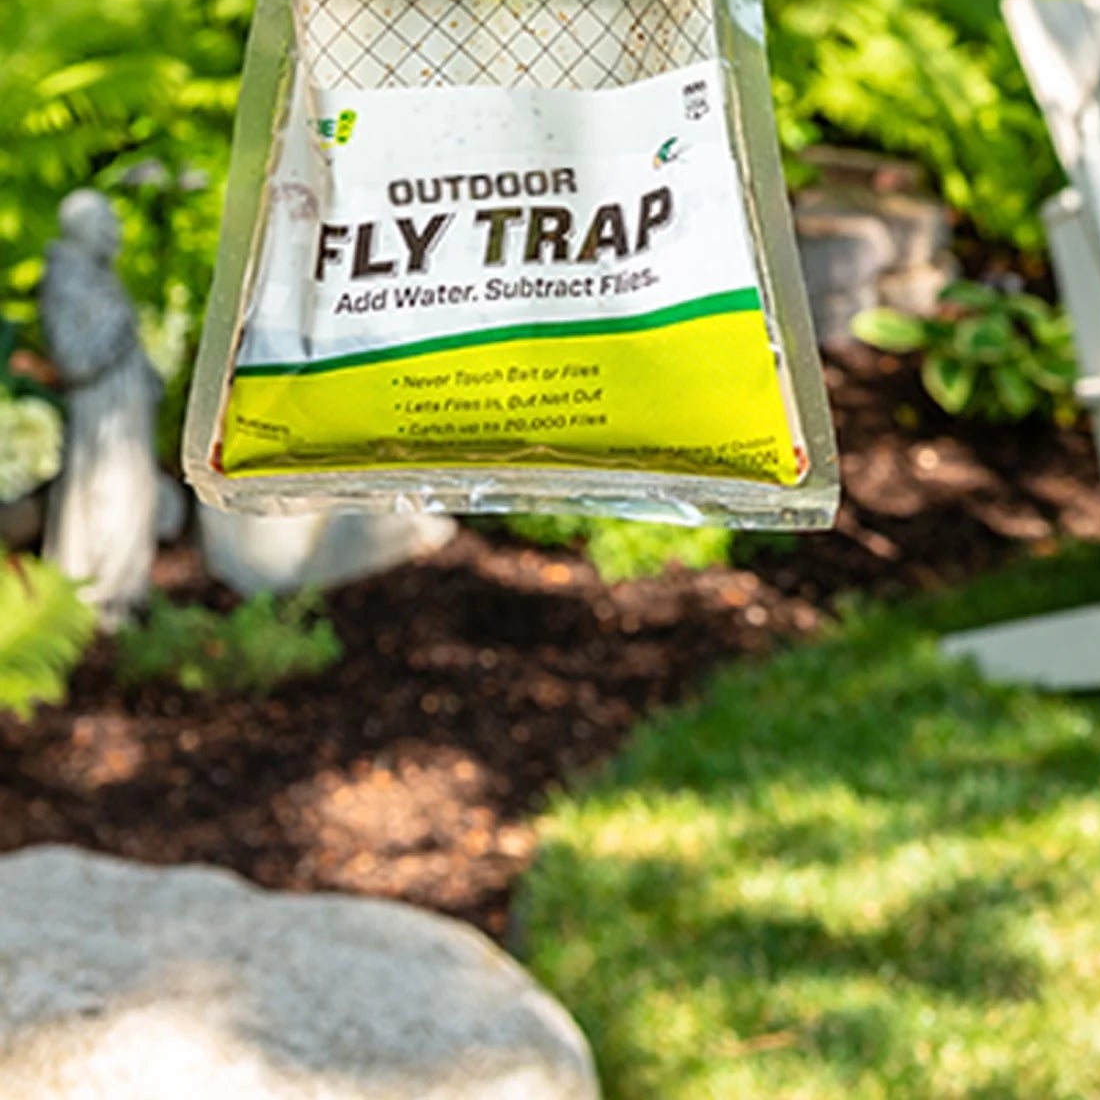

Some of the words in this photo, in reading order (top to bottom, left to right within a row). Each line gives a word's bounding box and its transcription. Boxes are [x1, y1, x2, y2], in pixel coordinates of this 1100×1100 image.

[388, 168, 577, 206] OUTDOOR
[314, 212, 455, 284] FLY
[474, 186, 672, 268] TRAP
[334, 288, 387, 315] Add
[396, 284, 478, 308] Water.
[485, 276, 593, 301] Subtract
[403, 375, 449, 388] Never
[455, 369, 503, 386] Touch
[573, 388, 603, 403] Out
[409, 422, 456, 437] Catch
[504, 415, 567, 433] 20,000
